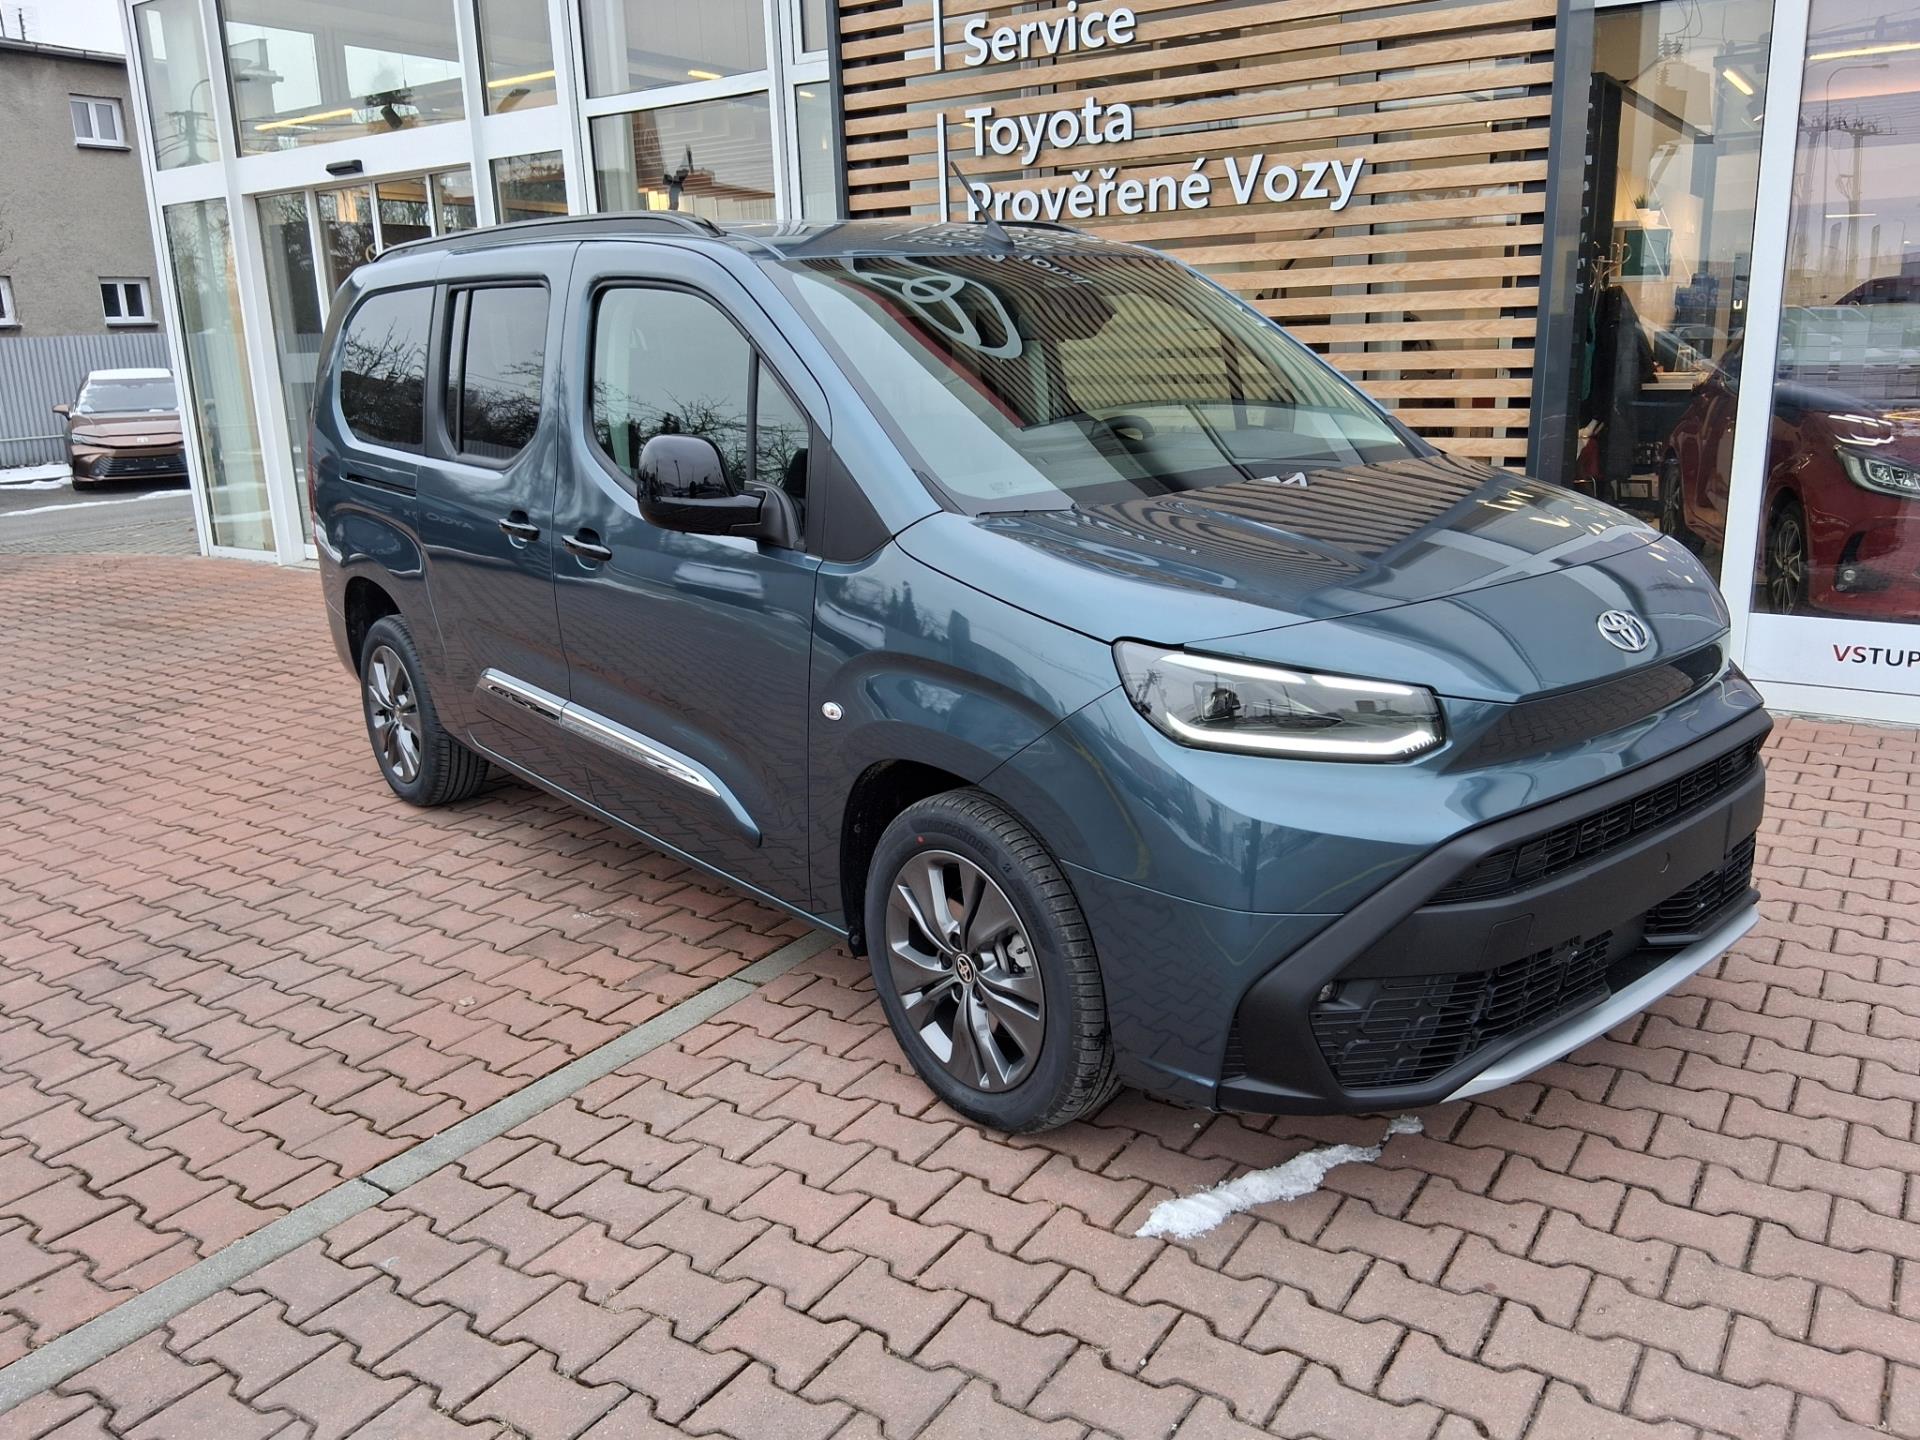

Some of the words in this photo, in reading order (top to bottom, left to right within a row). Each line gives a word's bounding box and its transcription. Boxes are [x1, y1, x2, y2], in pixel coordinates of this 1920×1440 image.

[964, 1, 1136, 67] Service
[965, 97, 1133, 165] Toyota
[967, 157, 1211, 222] Prověřené
[1225, 153, 1365, 211] Vozy
[1833, 644, 1920, 668] VSTUP
